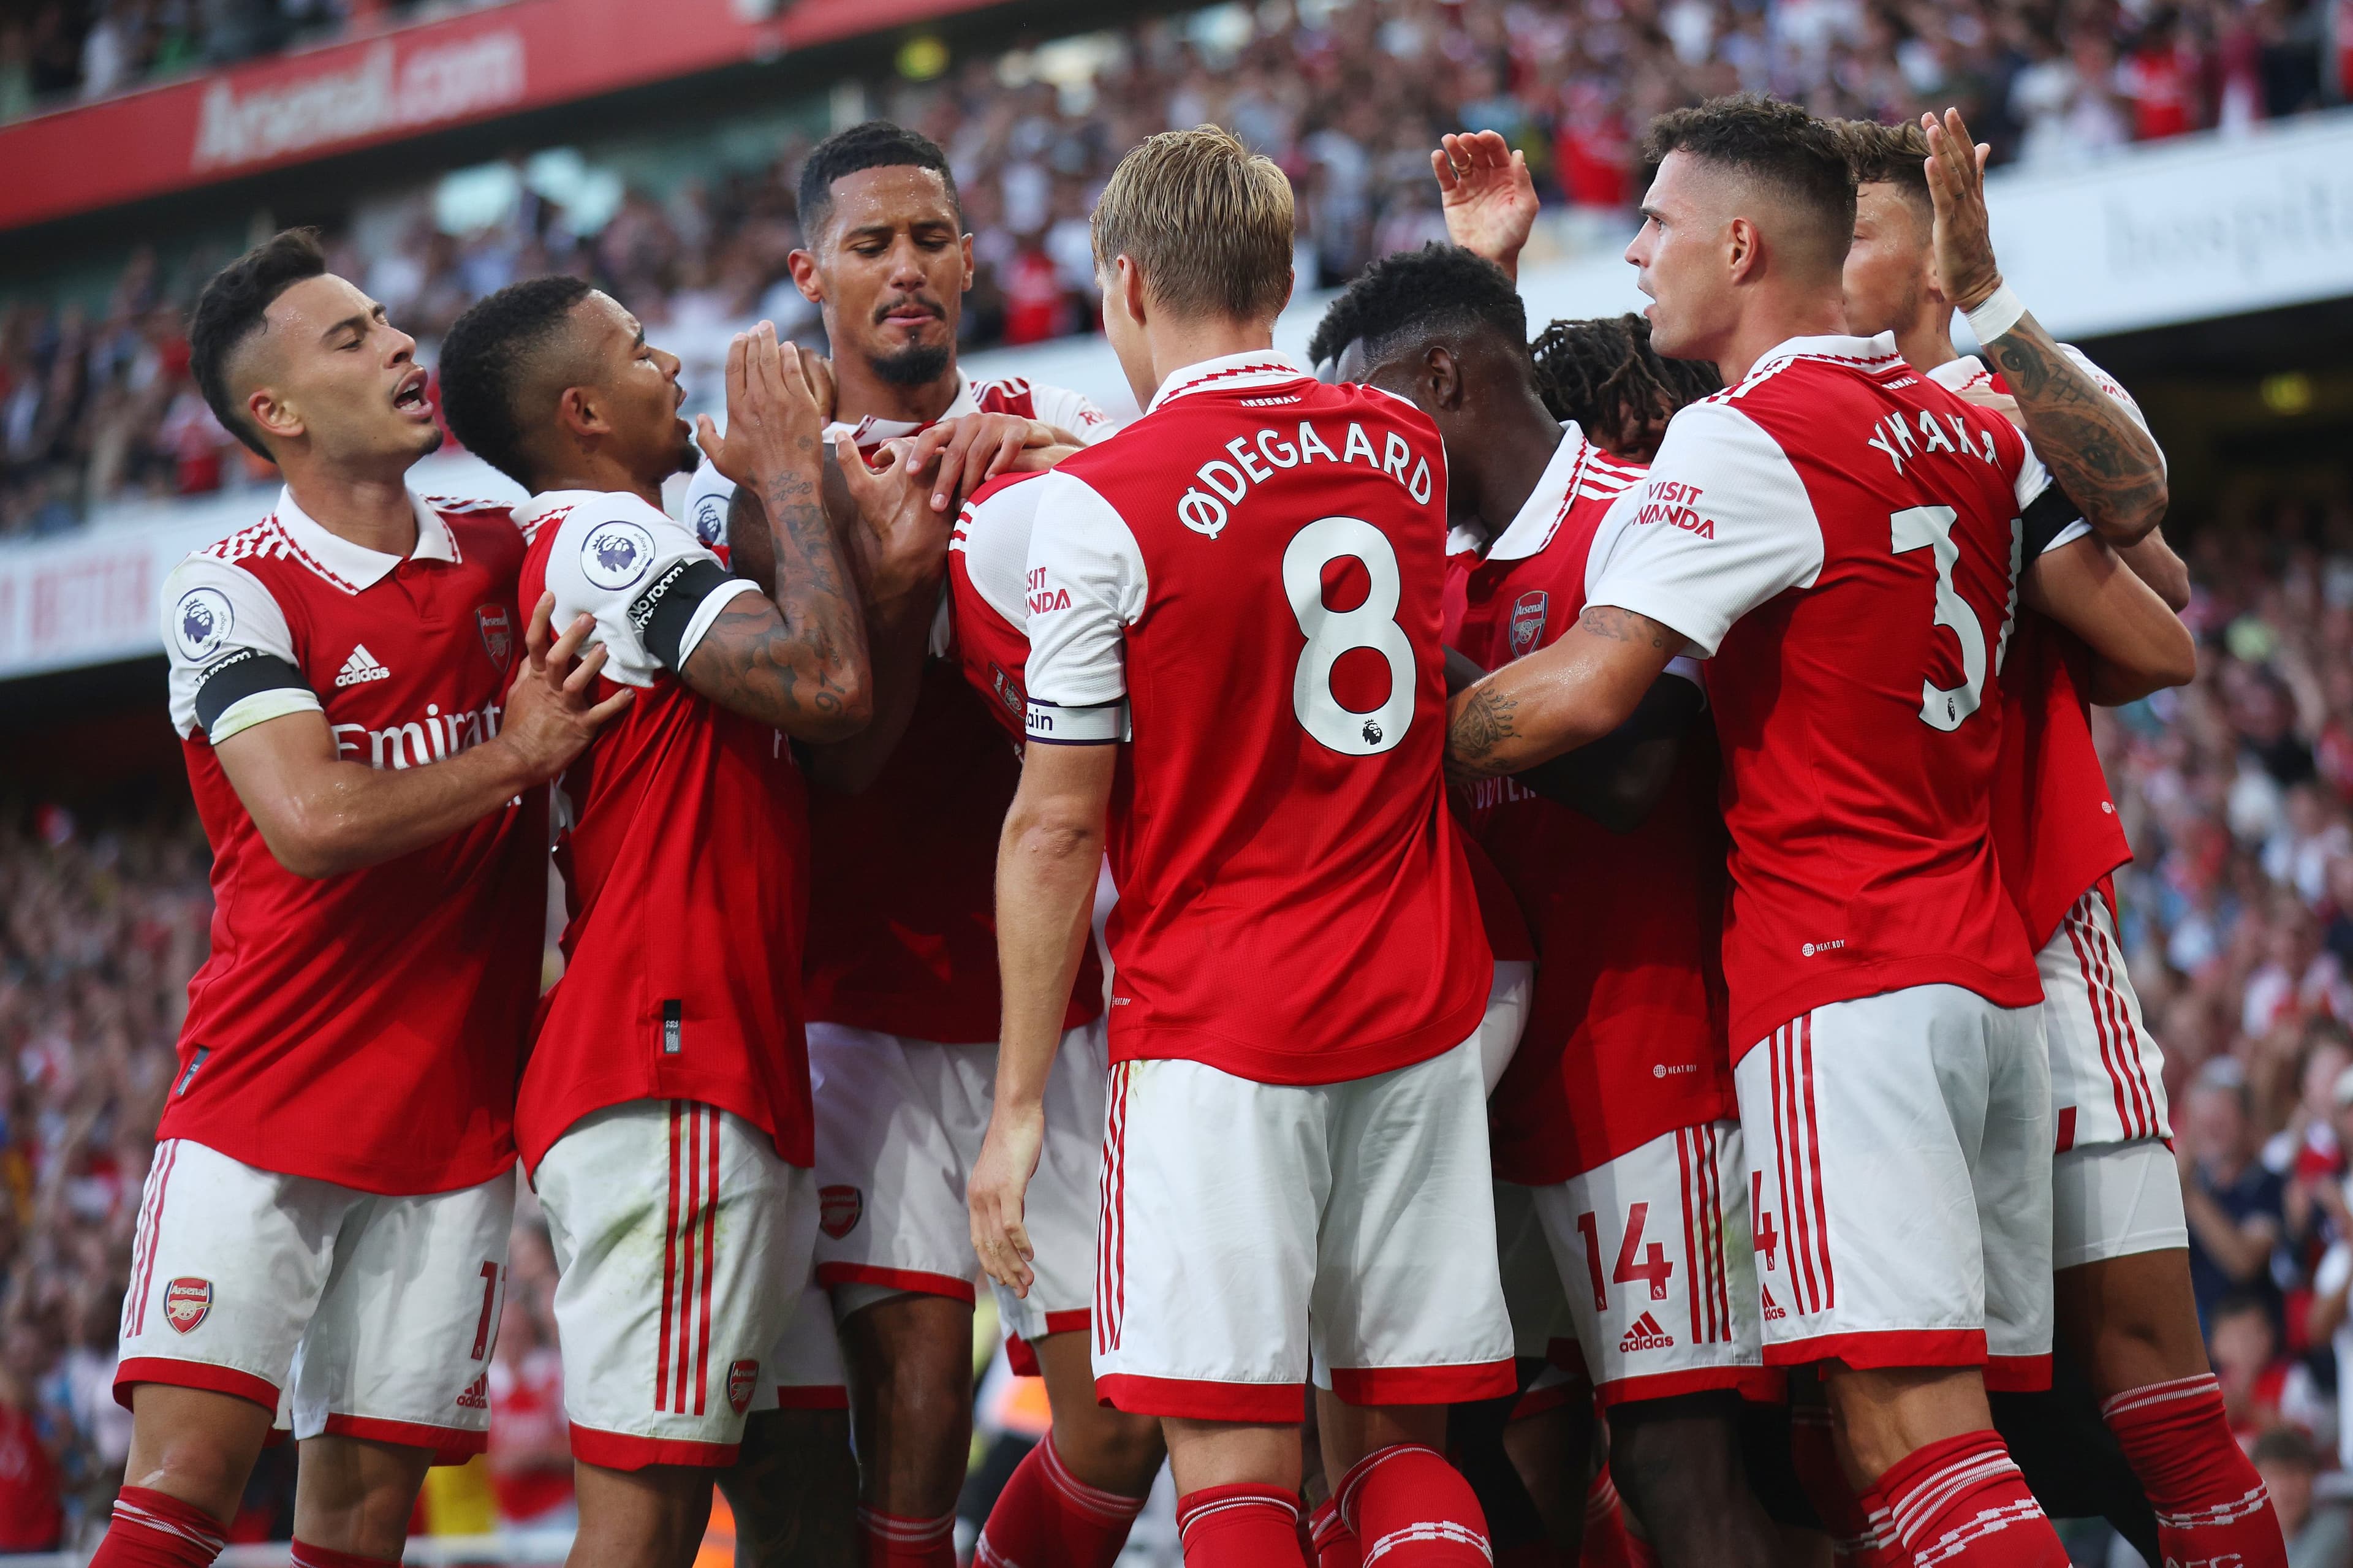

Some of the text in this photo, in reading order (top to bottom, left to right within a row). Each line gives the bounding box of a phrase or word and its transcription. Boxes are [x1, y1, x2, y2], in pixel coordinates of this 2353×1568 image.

[1240, 395, 1302, 407] ARSENAL
[1177, 420, 1431, 540] ØDEGAARD
[1648, 482, 1703, 506] VISIT
[628, 567, 684, 620] No room
[1517, 600, 1542, 616] Arsenal
[1890, 505, 2023, 732] 3
[1283, 515, 1415, 755] 8
[335, 667, 390, 687] adidas
[1025, 708, 1053, 730] ain
[331, 700, 501, 770] Emirat
[1816, 938, 1844, 952] HEAT.RDY
[1668, 1064, 1697, 1074] HEAT.RDY
[1577, 1201, 1673, 1312] 14
[171, 1285, 207, 1296] Arsenal
[1619, 1335, 1674, 1353] adidas
